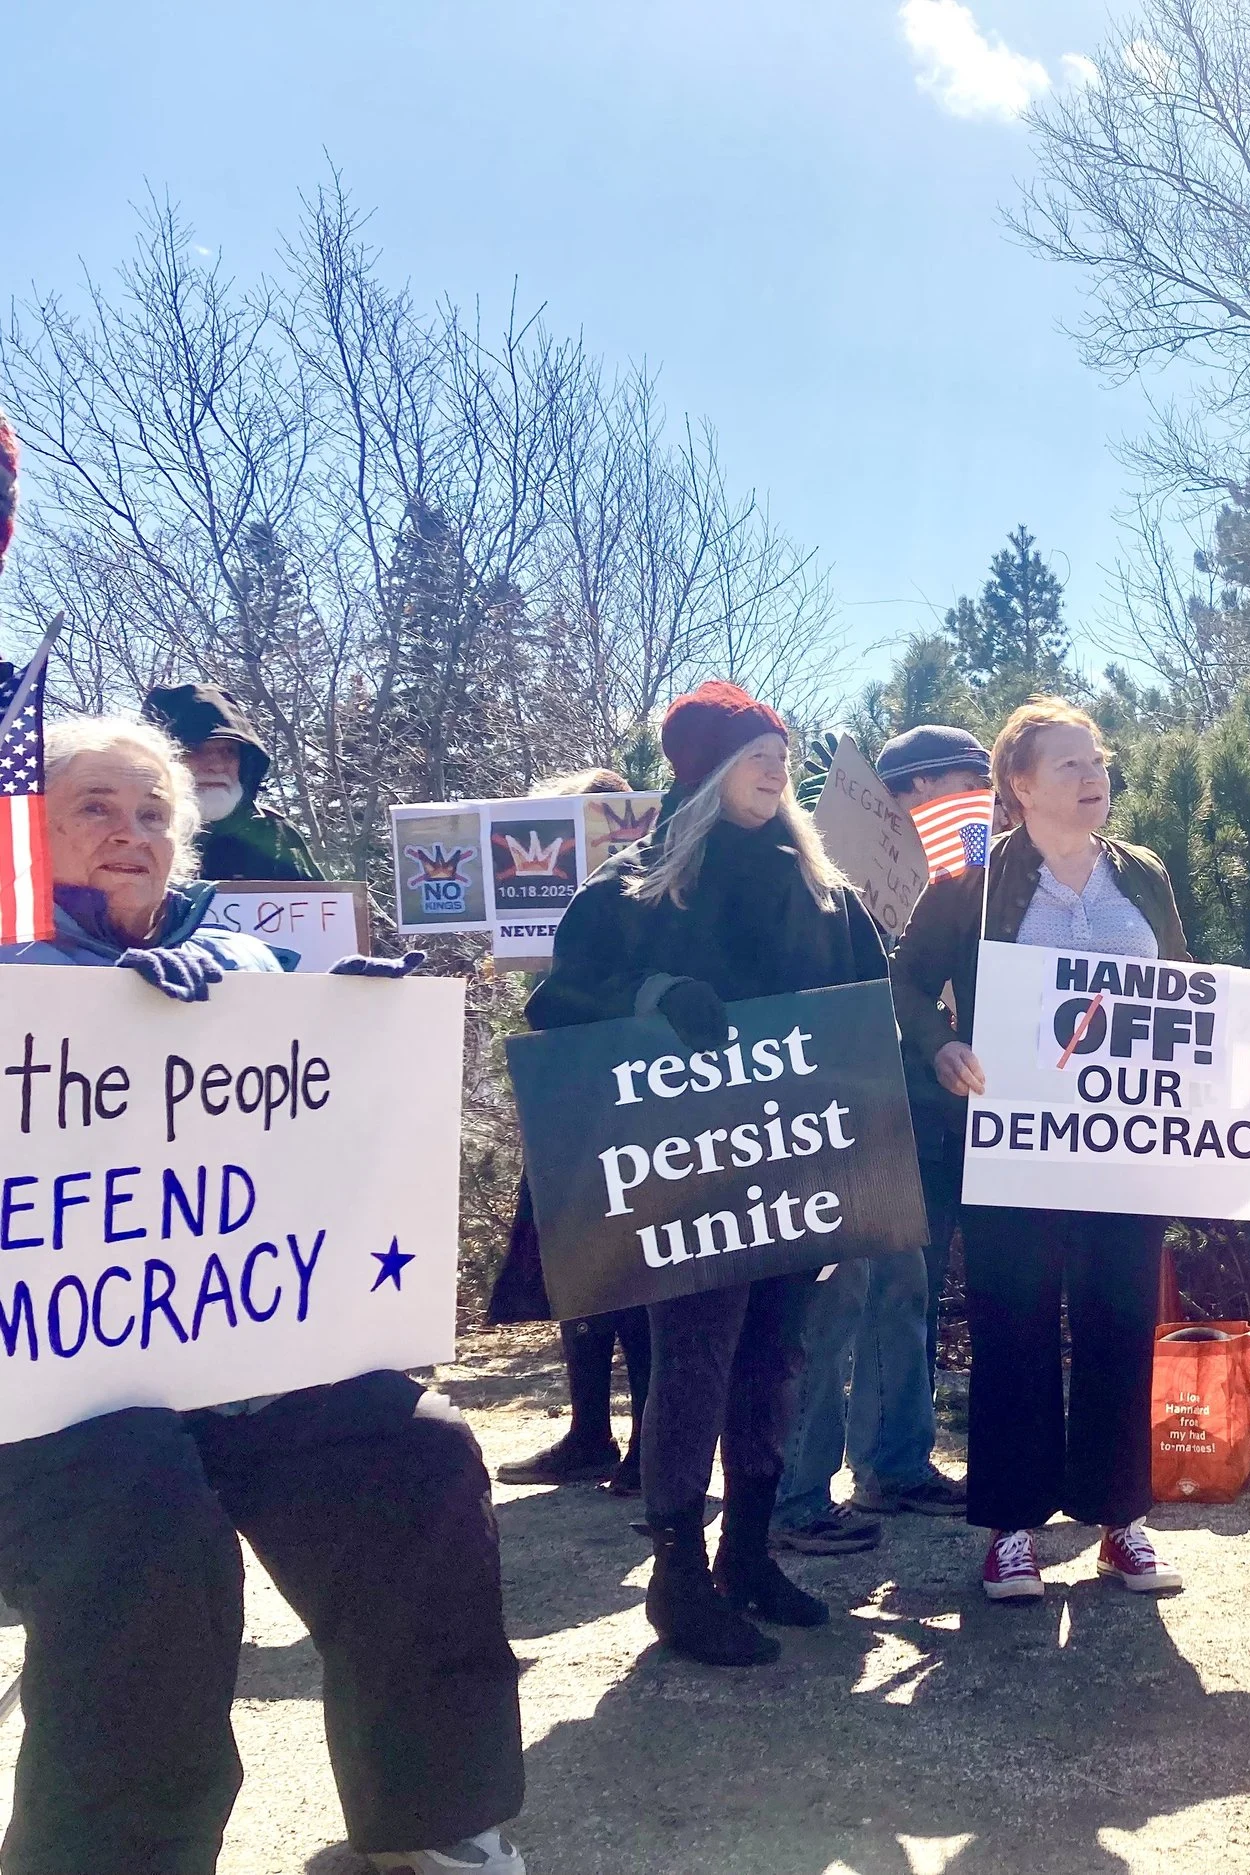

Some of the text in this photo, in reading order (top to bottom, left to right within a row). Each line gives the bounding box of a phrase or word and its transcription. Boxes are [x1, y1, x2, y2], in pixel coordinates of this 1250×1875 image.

[835, 768, 902, 835] REGIME
[878, 831, 899, 863] IN
[425, 882, 461, 900] NO
[425, 900, 462, 911] KINGS
[499, 885, 574, 898] 10.18.2025
[861, 879, 898, 929] NO
[1055, 957, 1216, 1005] HANDS
[1053, 996, 1215, 1065] OFF!
[5, 1032, 330, 1142] the people
[611, 1025, 818, 1106] resist
[1077, 1064, 1182, 1108] OUR
[598, 1099, 855, 1217] persist
[636, 1185, 843, 1268] unite
[1169, 1430, 1186, 1442] my
